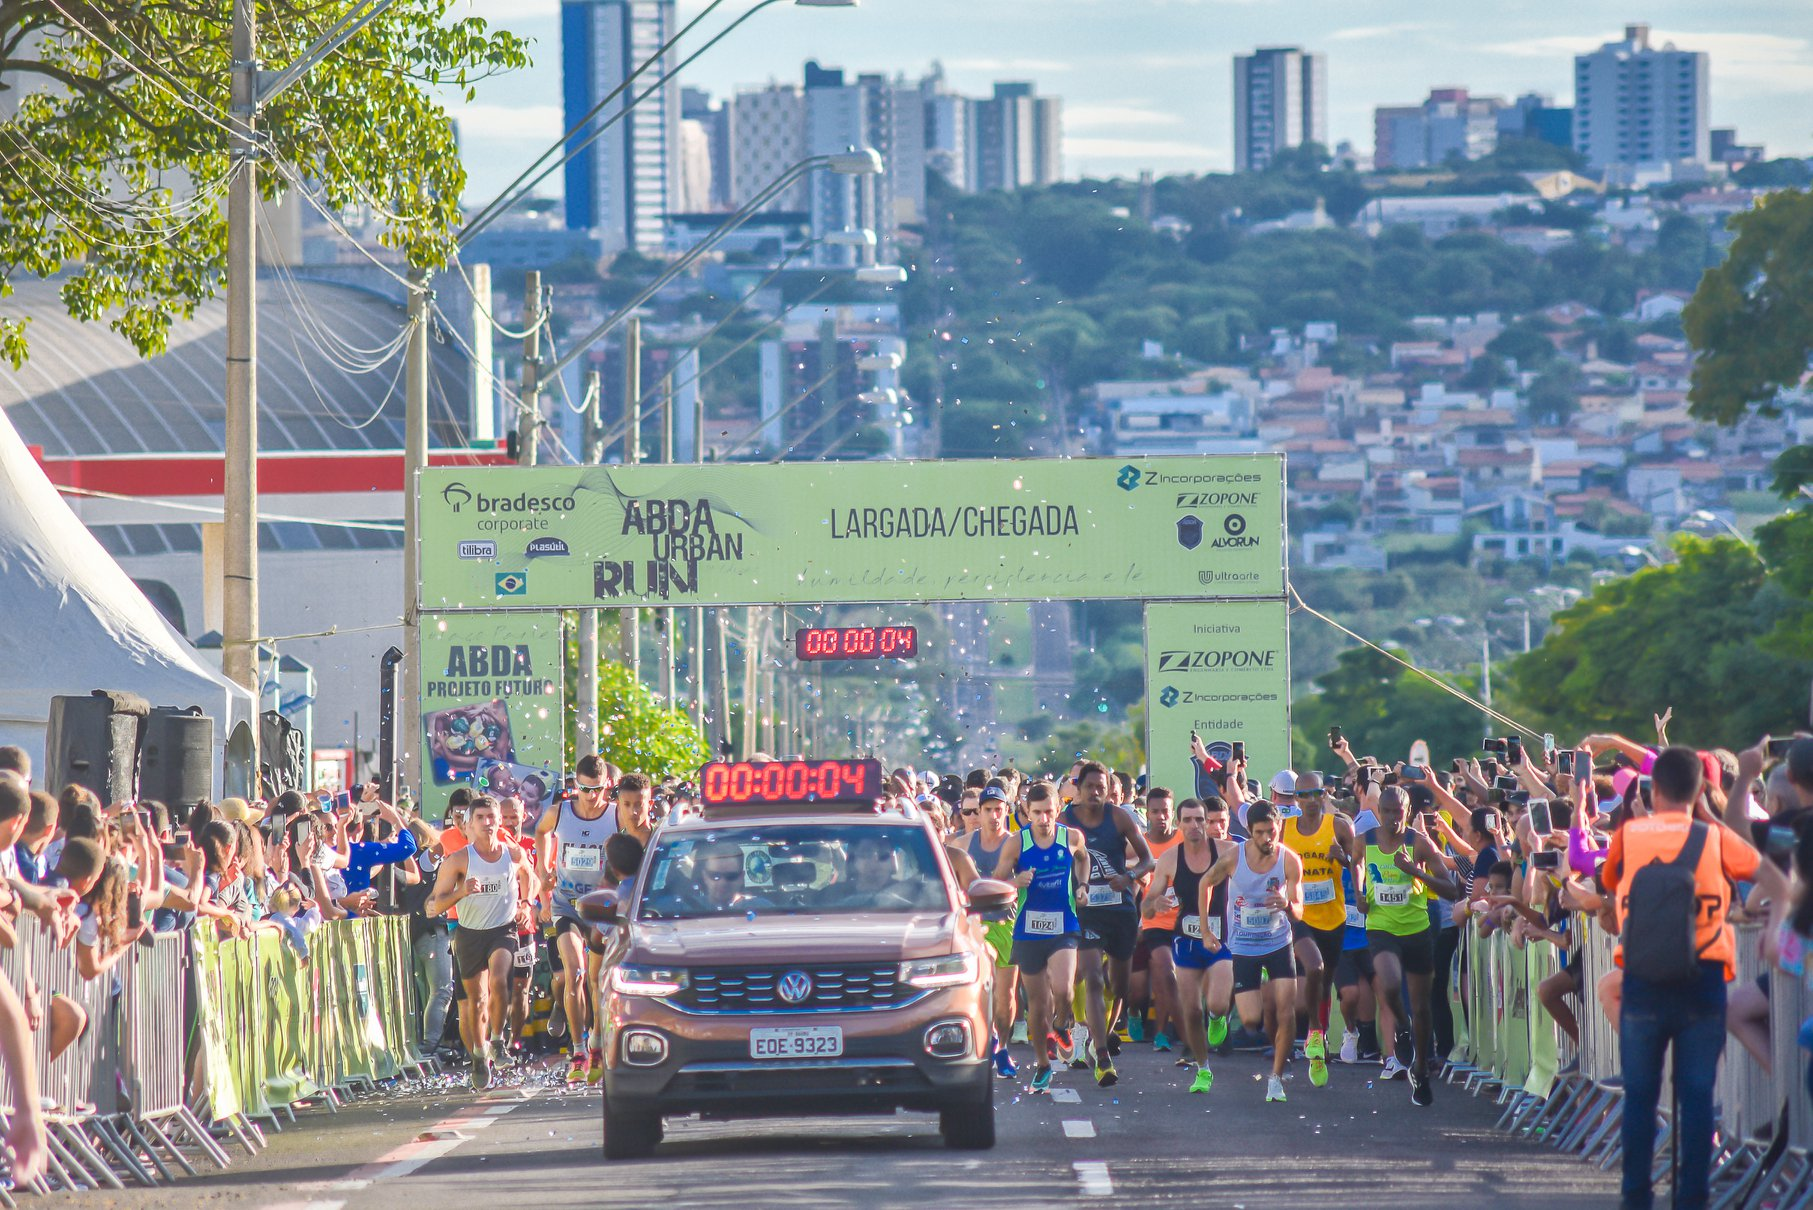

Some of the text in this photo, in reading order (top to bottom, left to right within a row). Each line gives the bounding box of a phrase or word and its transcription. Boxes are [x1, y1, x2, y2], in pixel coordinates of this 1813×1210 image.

[1160, 473, 1261, 484] Incorporações
[477, 492, 575, 512] bradesco
[1200, 493, 1258, 505] ZOPONE
[621, 499, 716, 535] ABDA
[831, 505, 1079, 538] LARGADA/CHEGADA
[477, 518, 548, 533] corporate
[462, 544, 492, 556] tilibra
[652, 533, 742, 561] URBAN
[1211, 537, 1259, 548] ALVORUN
[594, 560, 698, 600] RUN
[1215, 571, 1259, 581] ultraarte
[1193, 624, 1241, 634] Iniciativa
[807, 627, 912, 653] 00 00 04
[447, 645, 532, 677] ABDA
[1191, 651, 1275, 667] ZOPONE
[427, 681, 491, 697] PROJETO
[1195, 693, 1277, 702] Incorporações
[1194, 719, 1244, 730] Entidade
[705, 761, 865, 801] 00:00:04
[1032, 920, 1054, 930] 1024
